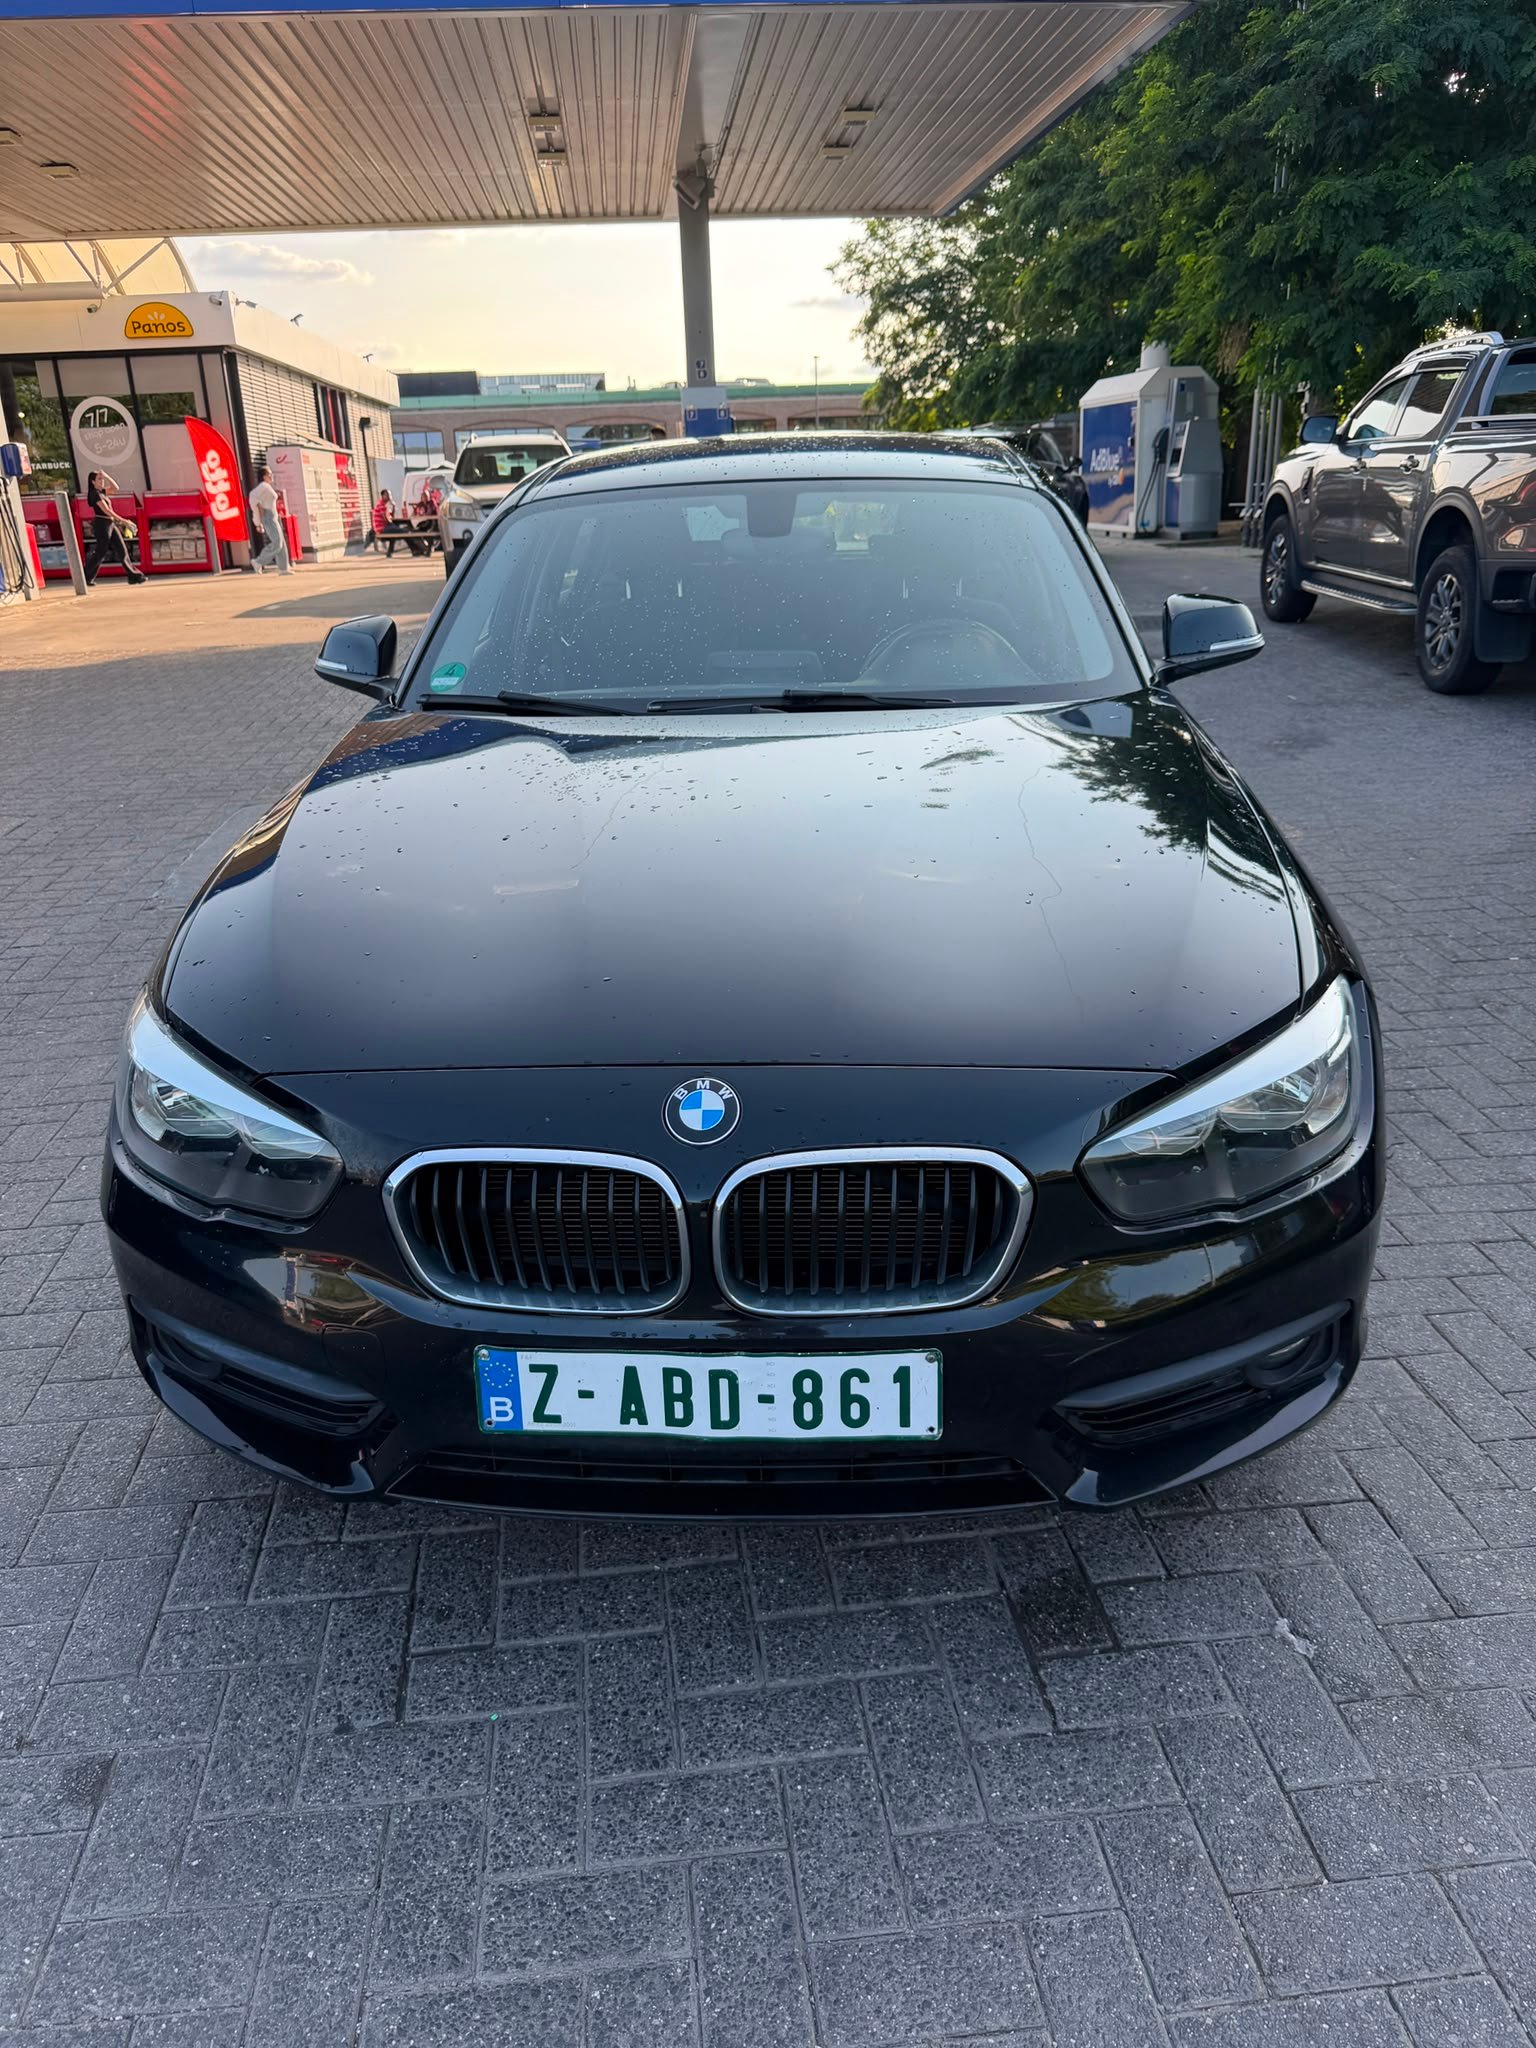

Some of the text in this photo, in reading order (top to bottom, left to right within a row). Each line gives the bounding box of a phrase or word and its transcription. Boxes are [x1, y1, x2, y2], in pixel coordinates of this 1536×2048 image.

[131, 321, 186, 334] Panos
[85, 408, 108, 428] 7/7
[31, 462, 73, 470] TARBUCK
[674, 1080, 733, 1101] BMW
[528, 1364, 911, 1430] Z-ABD-861
[490, 1397, 514, 1423] B
